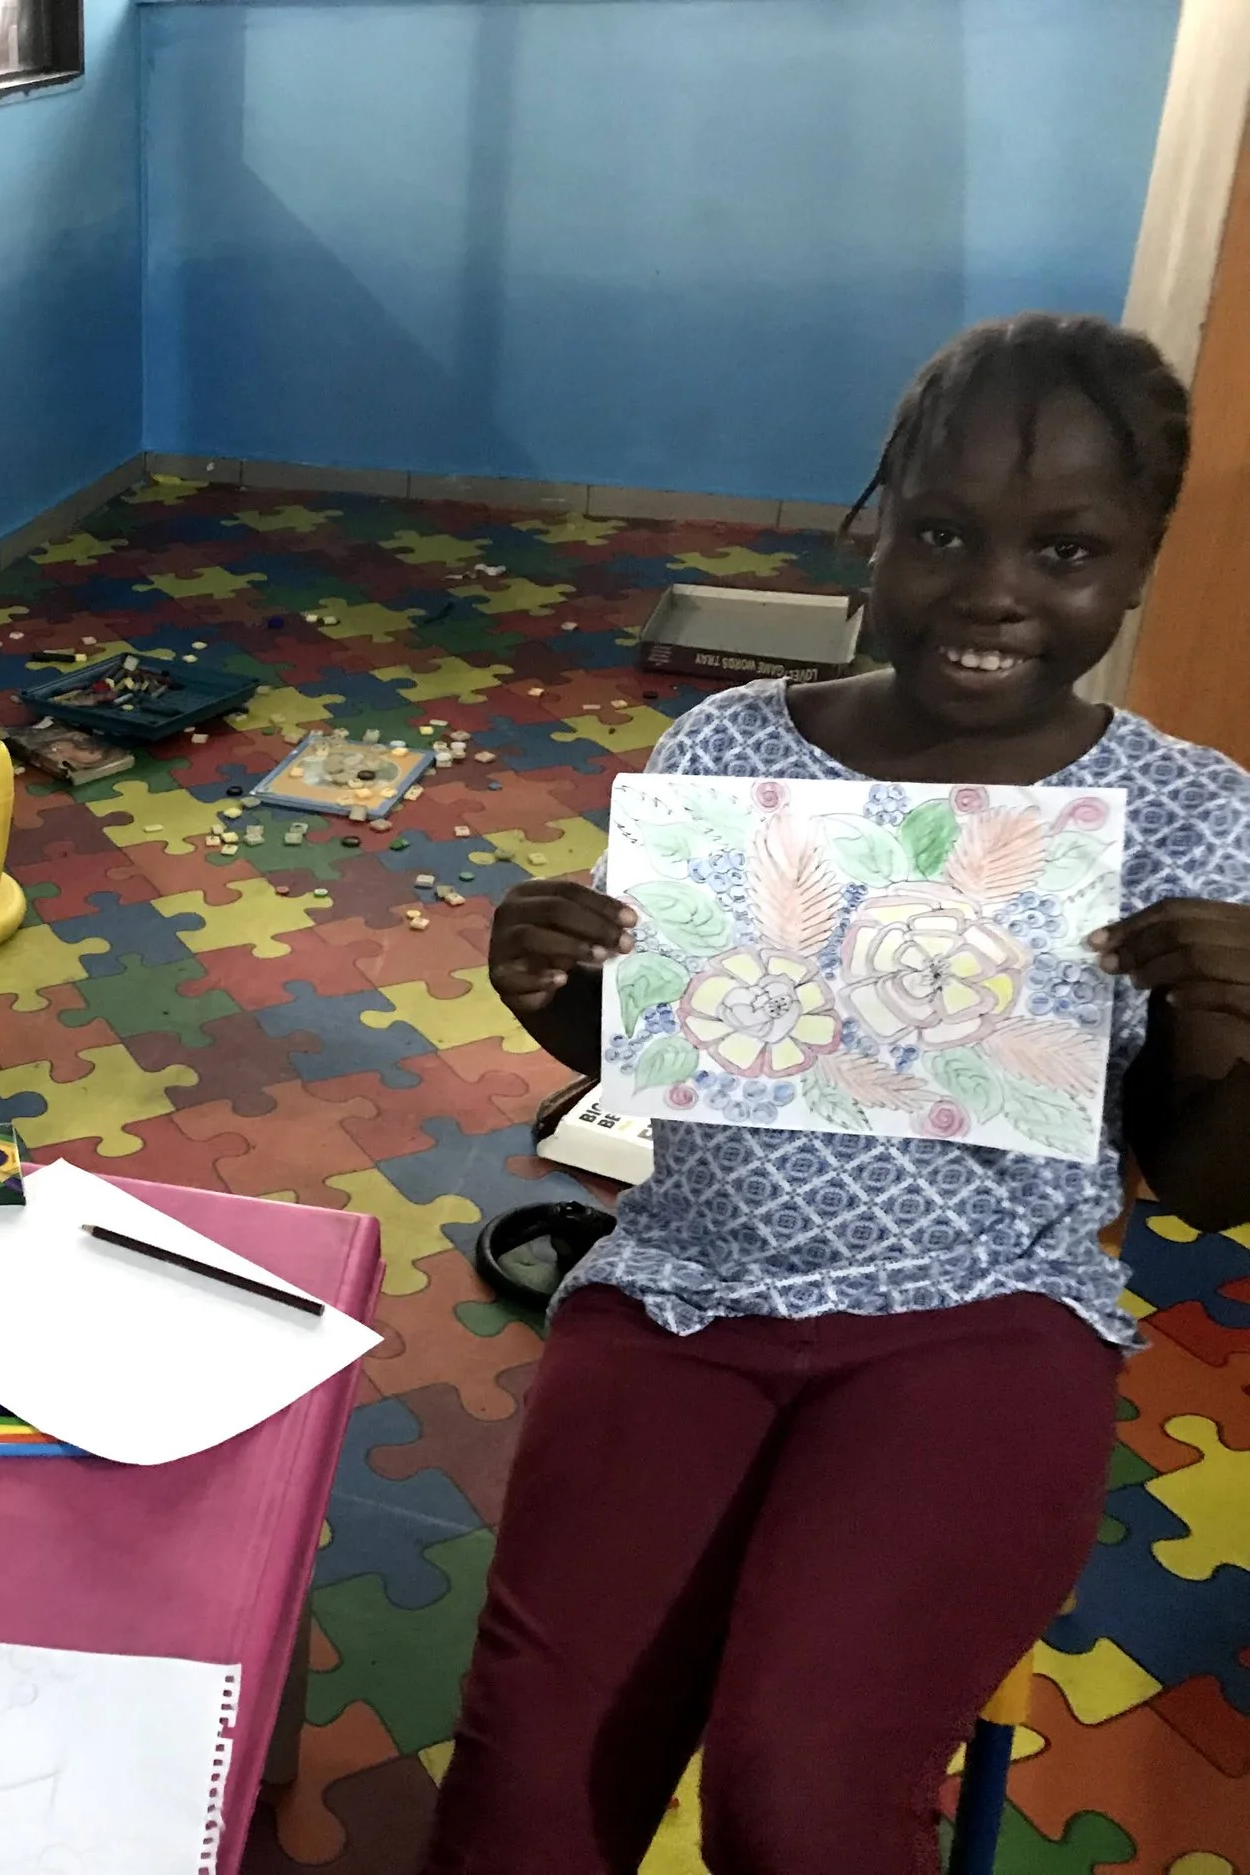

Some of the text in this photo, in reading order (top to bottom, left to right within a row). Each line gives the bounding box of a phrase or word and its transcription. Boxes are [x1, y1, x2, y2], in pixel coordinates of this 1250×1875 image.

[695, 653, 720, 667] TRAY
[721, 657, 756, 670] WORDS
[756, 661, 785, 677] GAME
